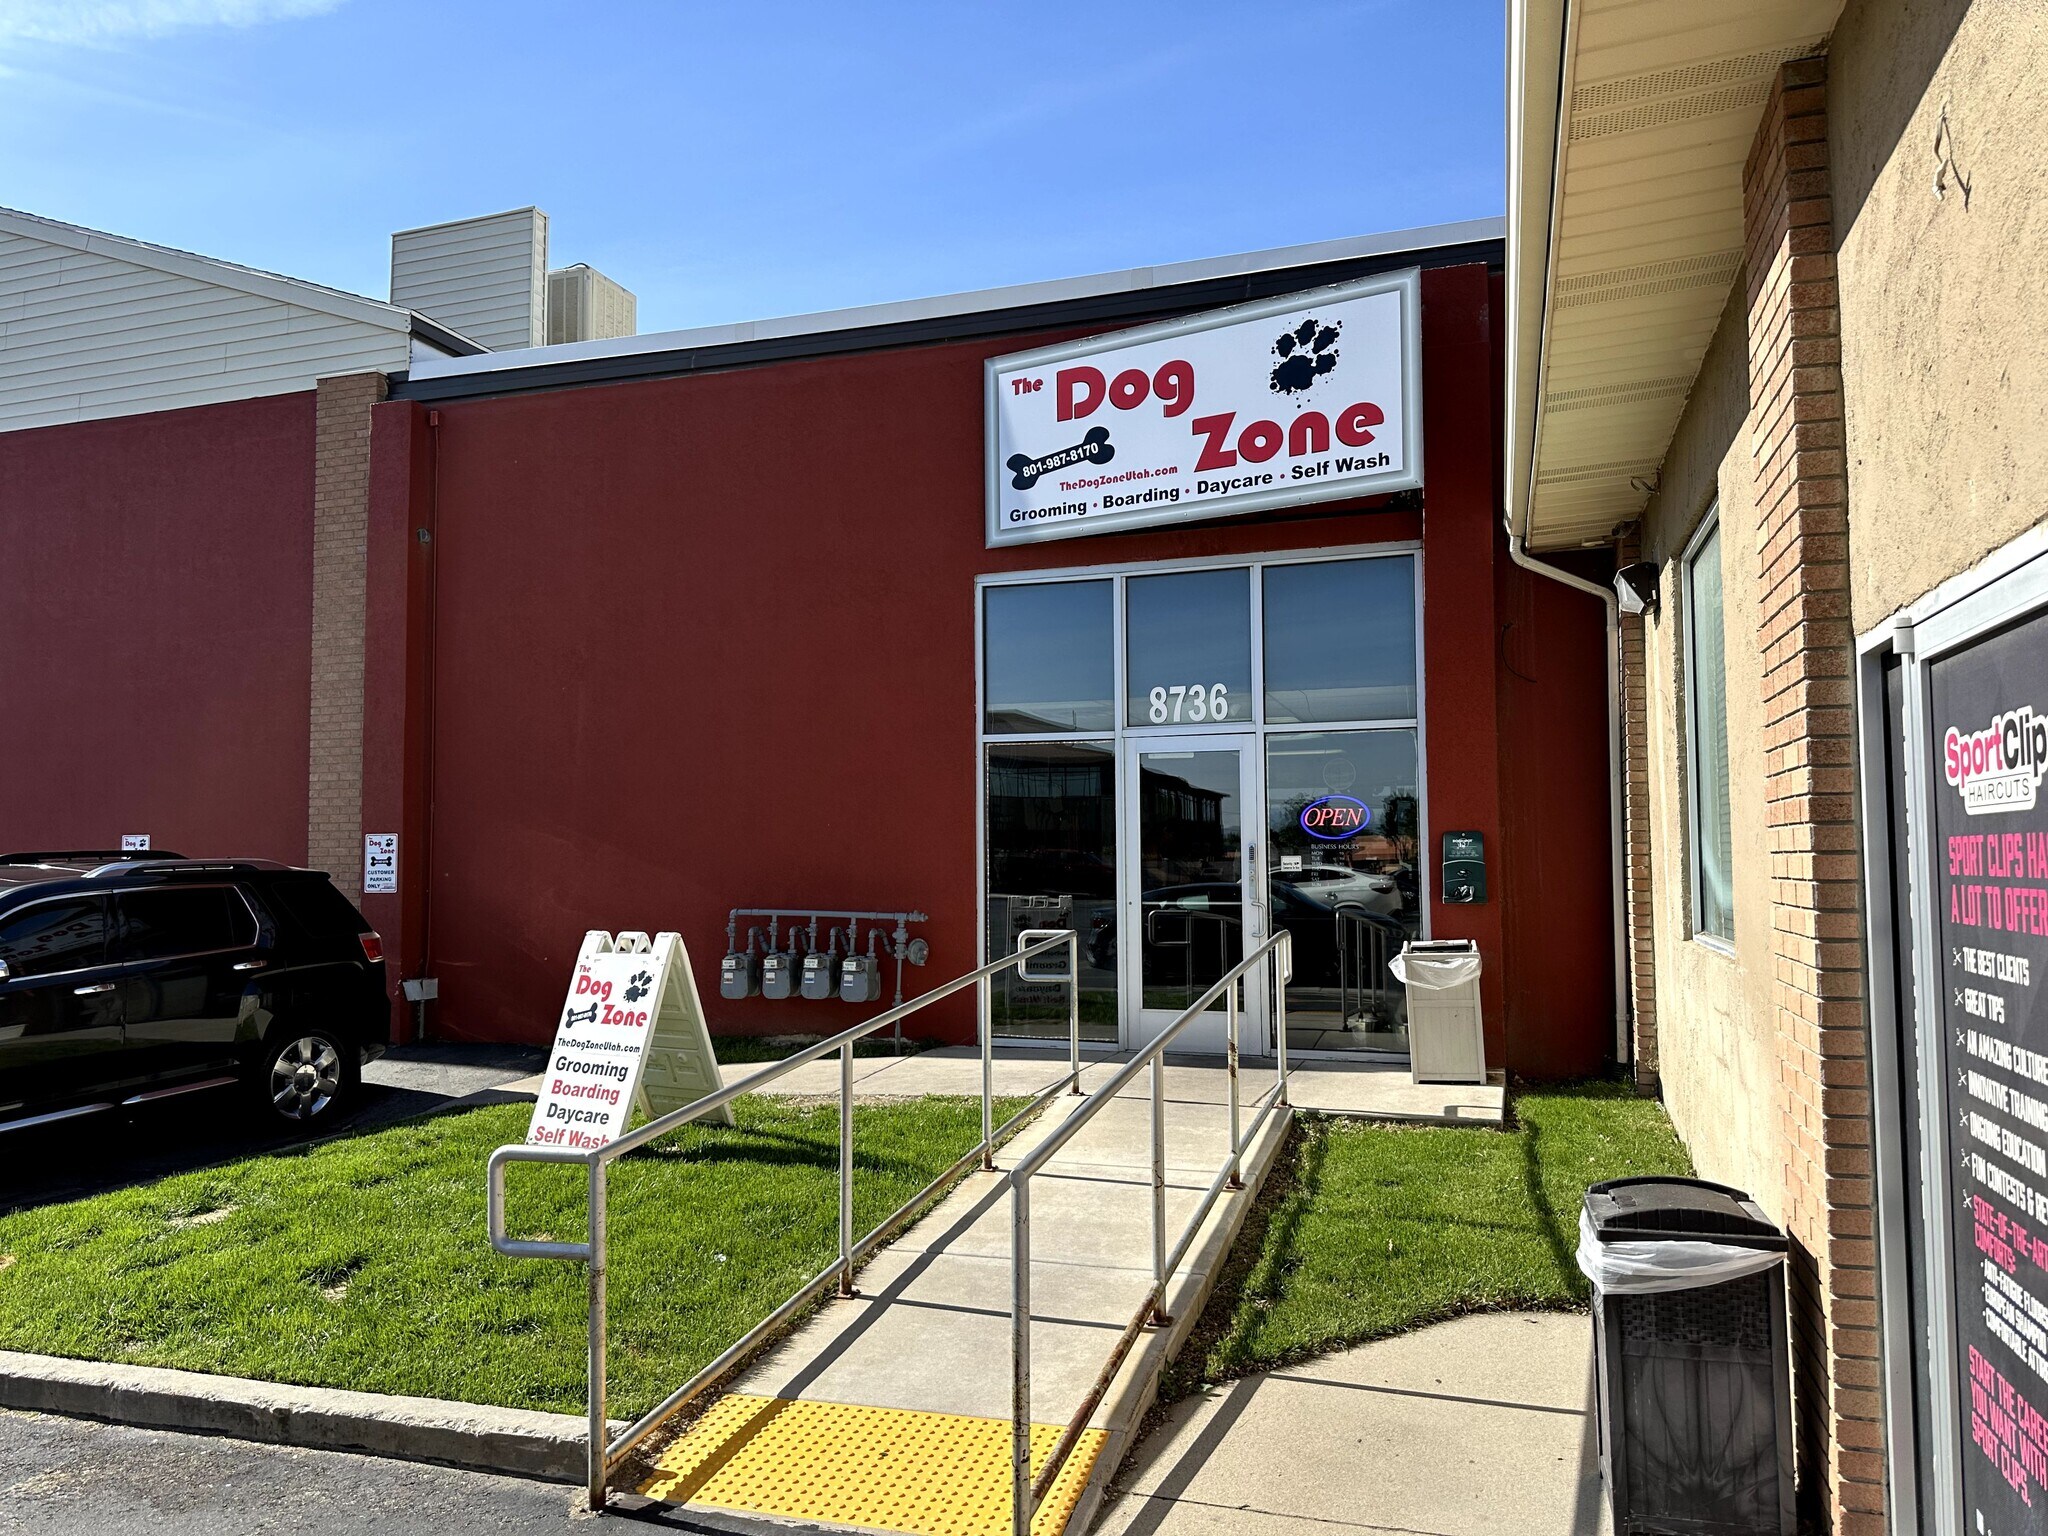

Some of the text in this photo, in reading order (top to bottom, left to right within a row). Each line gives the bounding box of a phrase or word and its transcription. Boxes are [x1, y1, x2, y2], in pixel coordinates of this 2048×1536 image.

[1011, 359, 1195, 422] The Dog
[1192, 402, 1385, 473] Zone
[1022, 441, 1099, 478] 801-987-8170
[1059, 465, 1178, 492] TheDogZoneUtah.com
[1009, 452, 1390, 523] Grooming Boarding Daycare Self Wash
[1149, 683, 1228, 724] 8736
[1968, 777, 2030, 802] HAIRCUTS
[1304, 808, 1363, 826] OPEN
[369, 840, 381, 848] Dog
[1949, 835, 1984, 876] SPORT
[1987, 833, 2023, 878] CLIPS
[1951, 884, 2048, 937] A LOT TO OFFER
[579, 965, 591, 974] The
[1962, 946, 2030, 987] THE BEST CLIENTS
[576, 975, 612, 1002] Dog
[1964, 987, 2005, 1024] GREAT TIPS
[601, 1004, 647, 1027] Zone
[557, 1037, 640, 1053] TheDogZoneUtah.com
[1967, 1028, 2048, 1086] AN AMAZING CULTURE
[556, 1056, 628, 1082] Grooming
[551, 1079, 620, 1105] Boarding
[1968, 1069, 2048, 1133] INNOVATIVE TRAINING
[547, 1103, 609, 1125] Daycare
[534, 1126, 610, 1150] Self Wash
[1969, 1111, 2047, 1178] ONGOING EDUCATION
[1971, 1152, 1987, 1185] FUN
[1986, 1162, 2026, 1211] CONTESTS
[2026, 1187, 2034, 1216] &
[1973, 1194, 2048, 1273] STATE-OF-THE-ART
[1974, 1222, 2016, 1274] COMFORTS:
[1969, 1344, 1995, 1397] START
[1996, 1372, 2016, 1420] THE
[1970, 1376, 2047, 1491] YOU WANT WITH
[1972, 1410, 2032, 1508] SPORT CLIPS.
